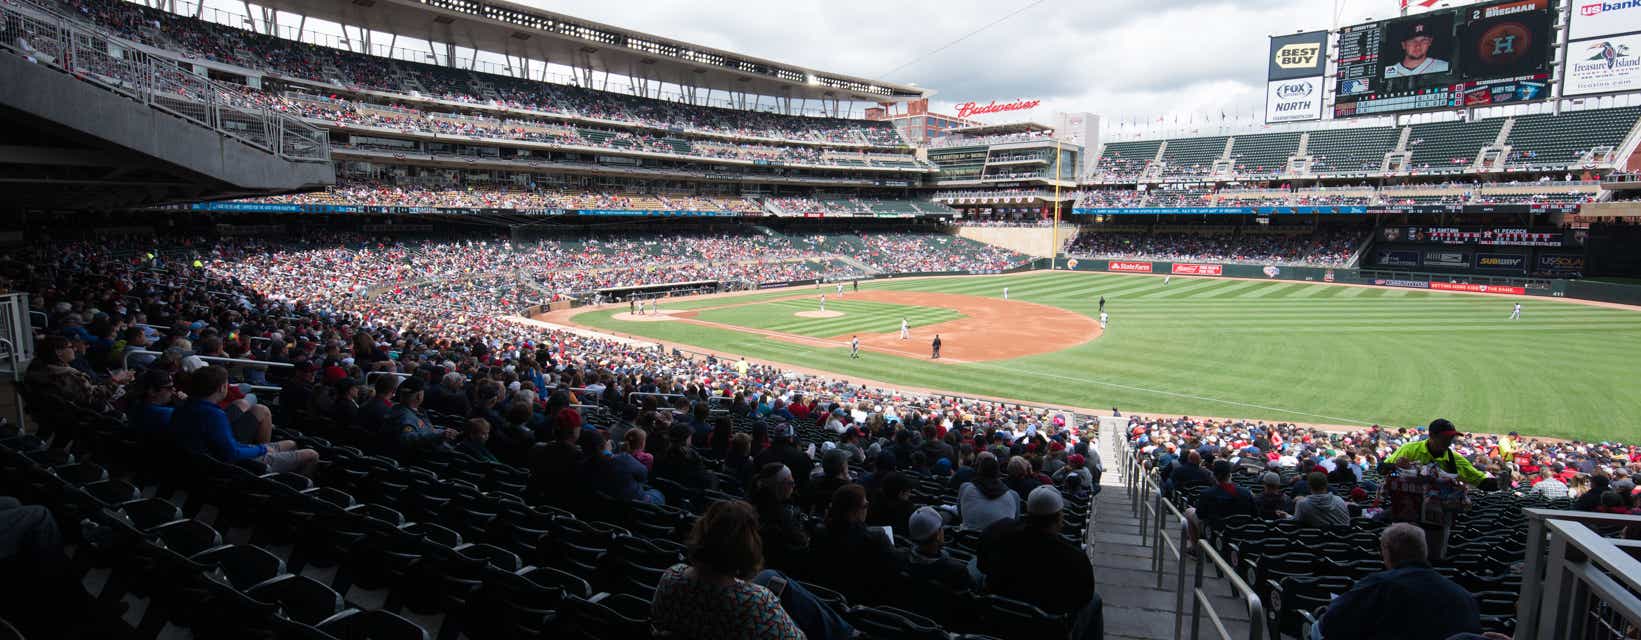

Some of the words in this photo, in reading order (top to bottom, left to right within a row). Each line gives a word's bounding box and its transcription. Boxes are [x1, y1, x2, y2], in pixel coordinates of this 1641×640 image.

[1473, 10, 1480, 19] 2
[1485, 3, 1536, 18] BREGMAN
[1282, 48, 1318, 57] BEST
[1282, 56, 1313, 65] BUY
[1573, 63, 1607, 73] Treasure
[1615, 56, 1640, 68] Island
[1284, 84, 1304, 94] FOX
[955, 98, 1040, 118] Budweiser
[1276, 101, 1312, 112] NORTH
